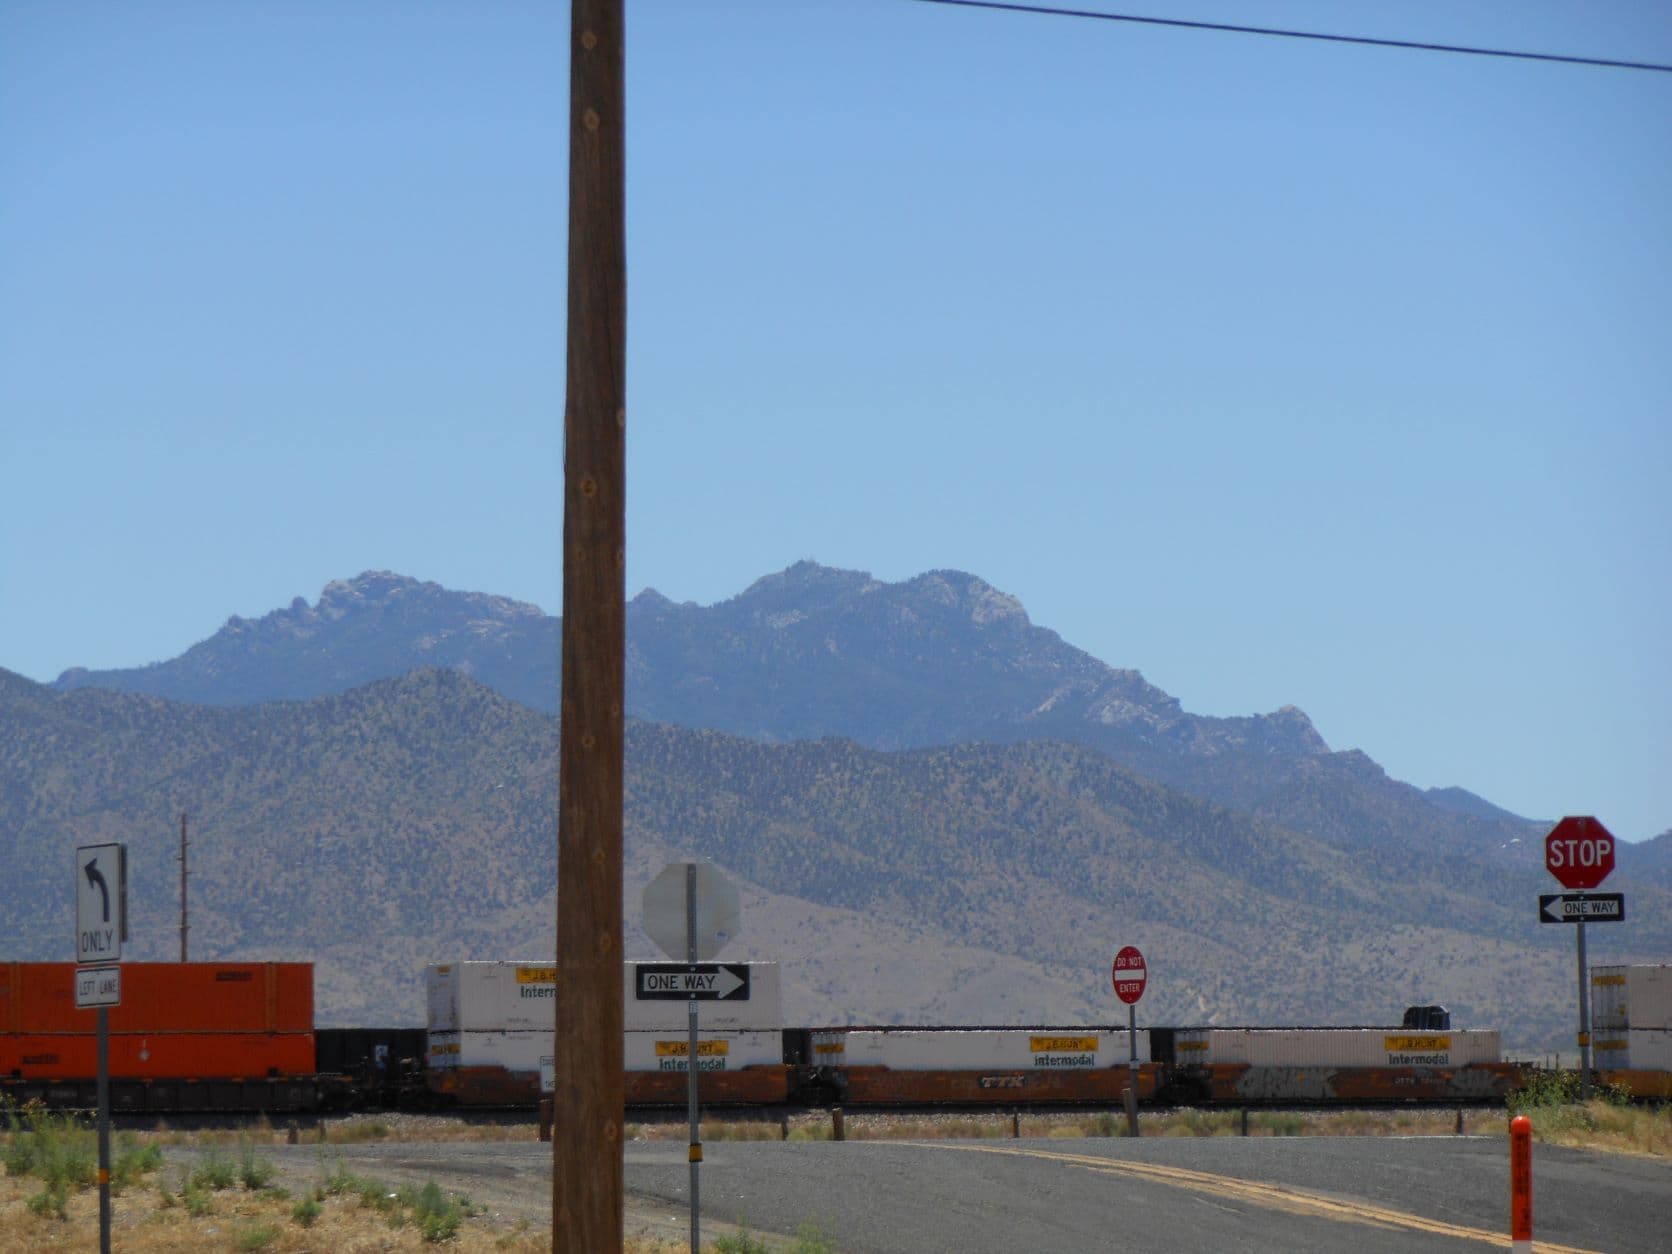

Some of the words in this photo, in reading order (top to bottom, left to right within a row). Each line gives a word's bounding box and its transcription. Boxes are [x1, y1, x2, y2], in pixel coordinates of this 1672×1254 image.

[1549, 839, 1611, 867] STOP
[1564, 902, 1587, 914] ONE
[1591, 902, 1615, 913] WAY
[82, 928, 114, 953] ONLY
[1117, 957, 1126, 968] DO
[1129, 956, 1142, 968] NOT
[79, 980, 96, 996] LEFT
[99, 978, 118, 994] LANE
[647, 975, 678, 990] ONE
[684, 975, 716, 990] WAY
[1119, 983, 1141, 994] ENTER
[1388, 1054, 1449, 1065] Intermodal
